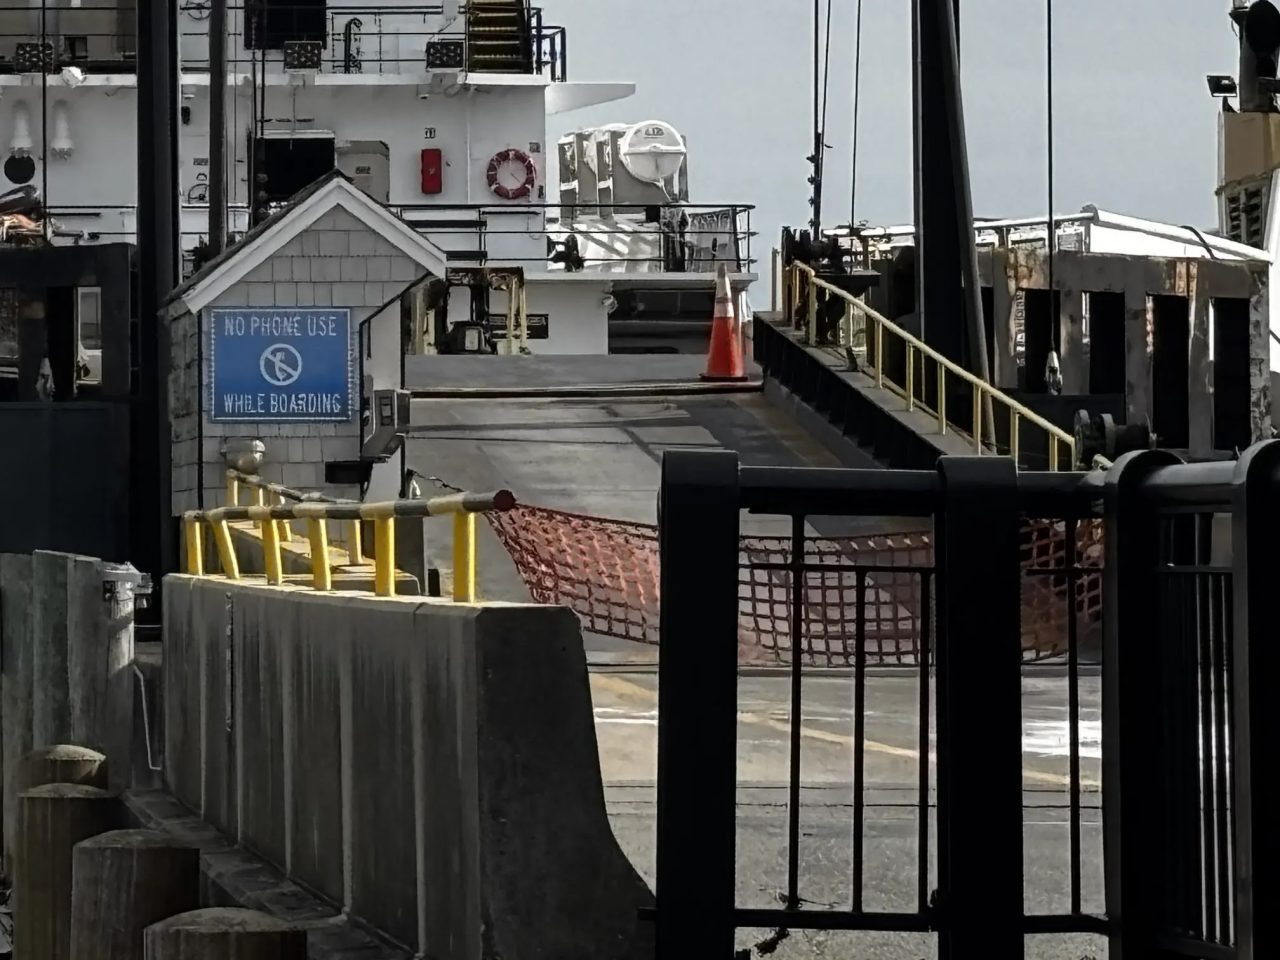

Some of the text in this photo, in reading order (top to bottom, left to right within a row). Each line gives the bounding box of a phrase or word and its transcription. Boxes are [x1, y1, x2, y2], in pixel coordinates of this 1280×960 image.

[224, 315, 337, 337] NO PHONE USE
[223, 393, 341, 413] WHILE BOARDING
